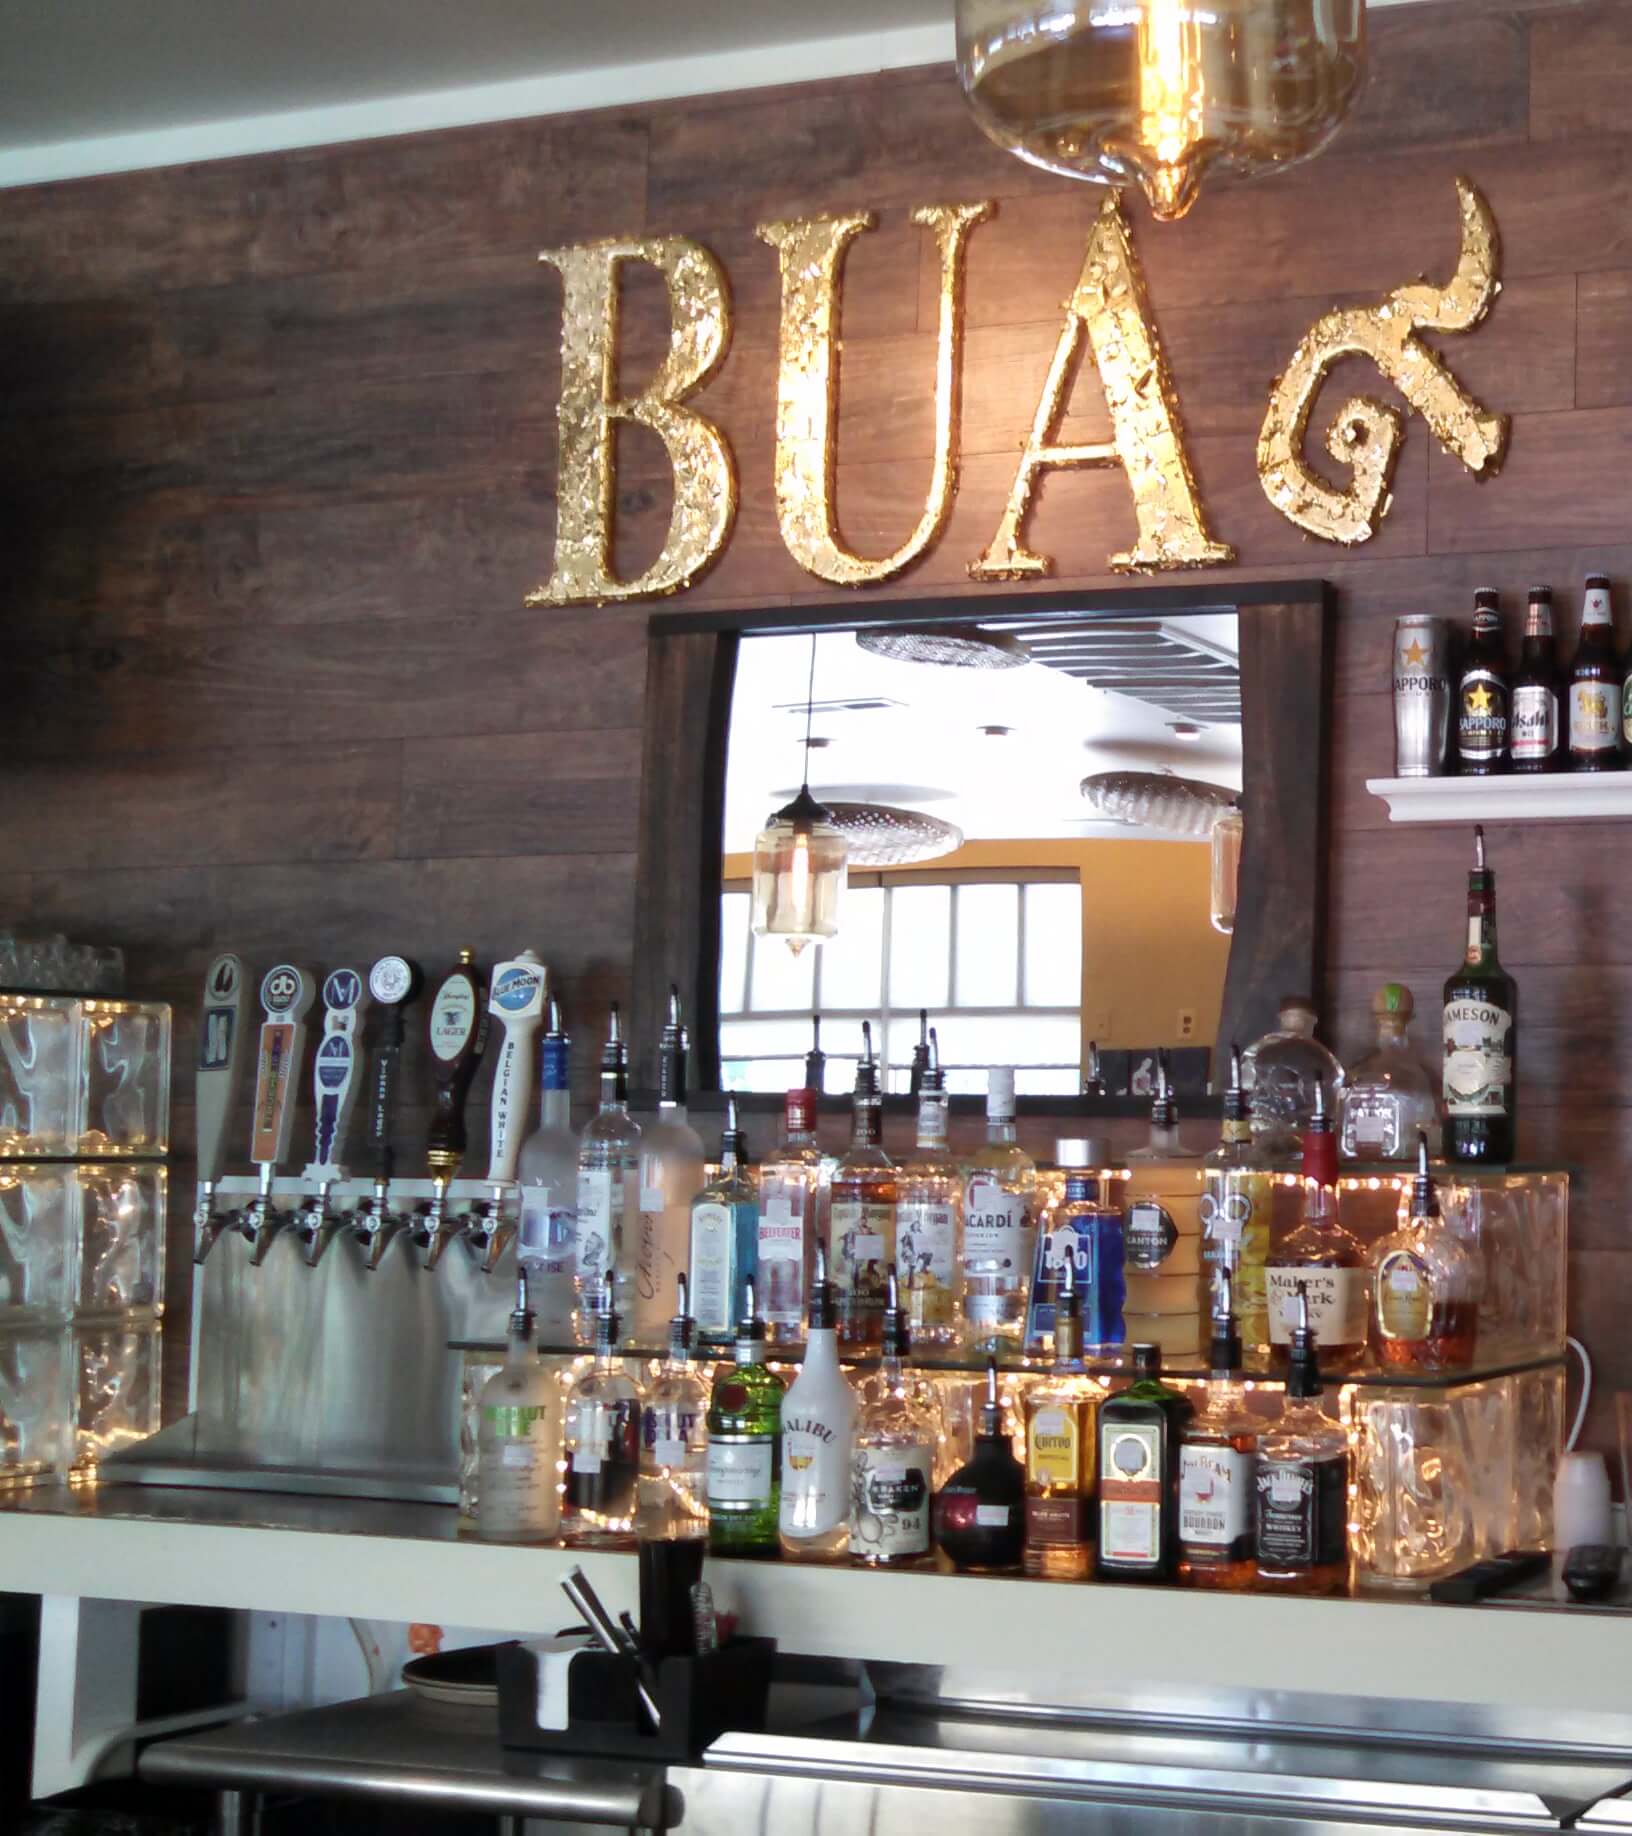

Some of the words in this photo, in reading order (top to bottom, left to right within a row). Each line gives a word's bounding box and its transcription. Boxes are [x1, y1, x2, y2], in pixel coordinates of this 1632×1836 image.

[524, 187, 1237, 607] BUA
[1393, 677, 1447, 690] APPORO
[512, 976, 541, 991] MOON
[1446, 1006, 1500, 1026] AMESON
[500, 1041, 515, 1106] BELGIAN
[496, 1111, 508, 1158] WHITE
[965, 1209, 1013, 1228] CARDÍ
[902, 1519, 920, 1531] 94
